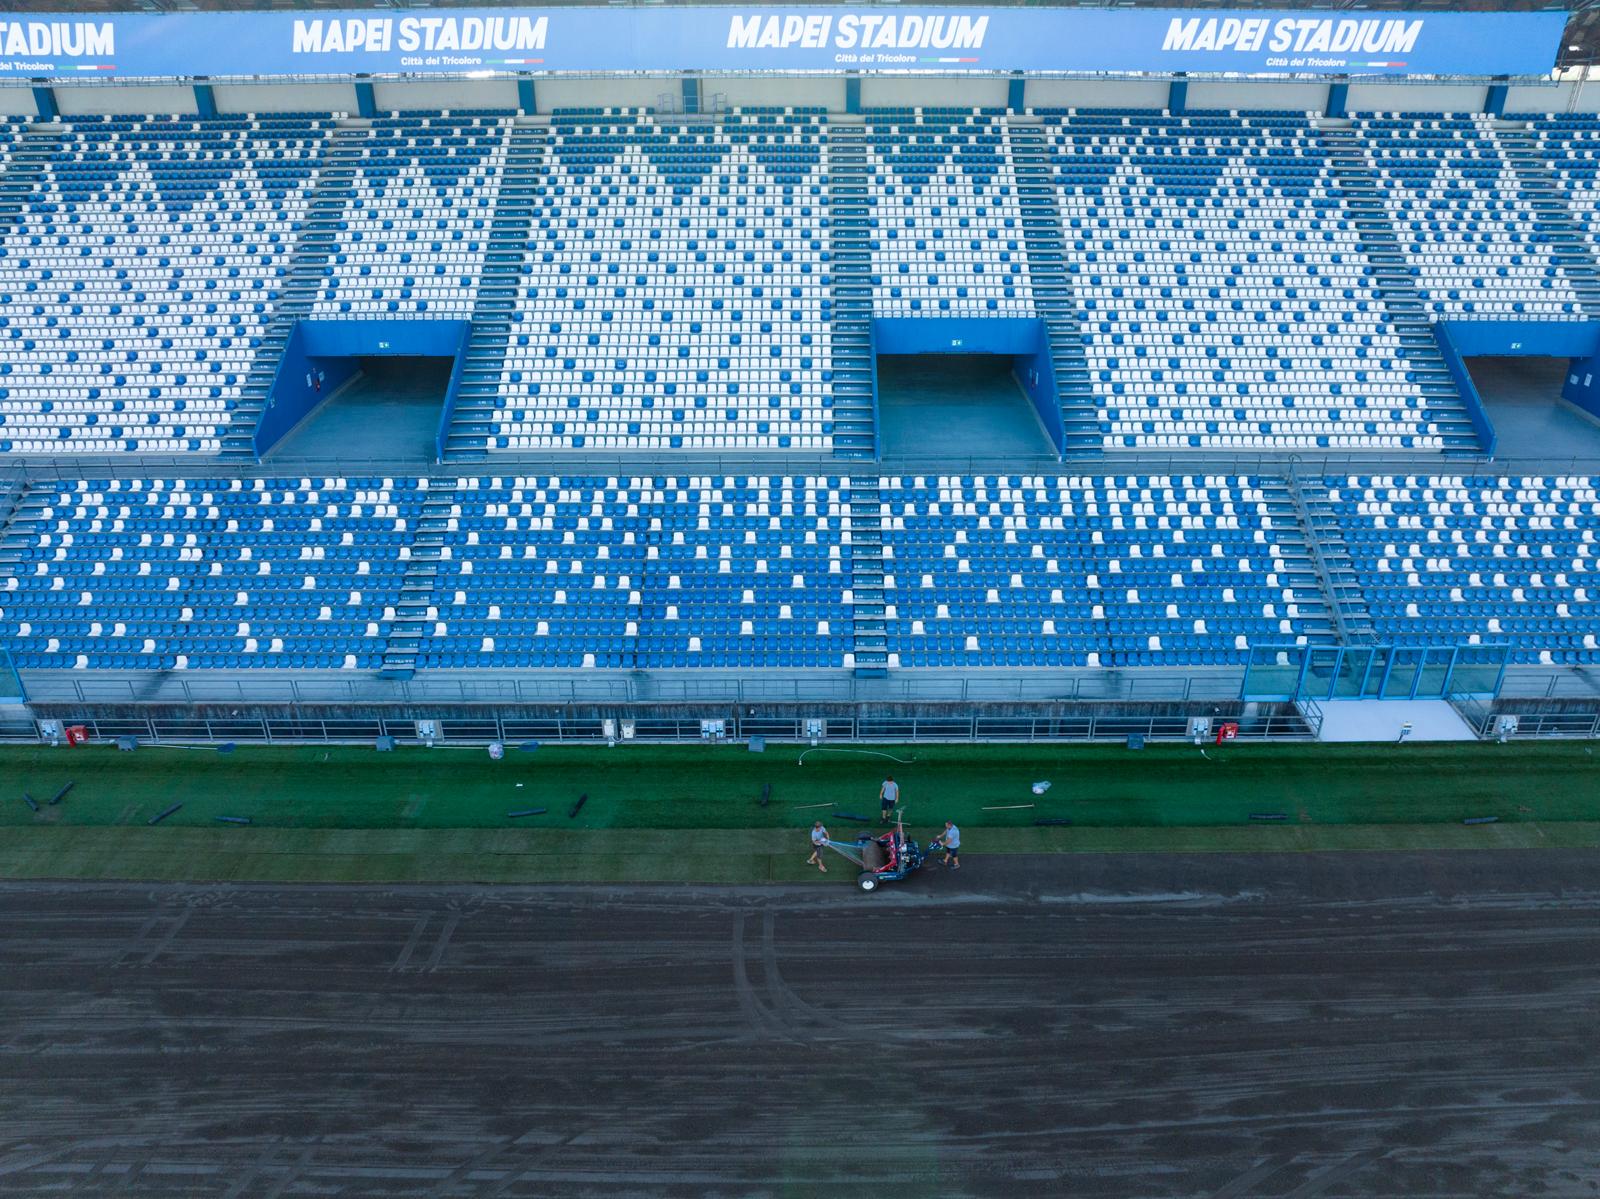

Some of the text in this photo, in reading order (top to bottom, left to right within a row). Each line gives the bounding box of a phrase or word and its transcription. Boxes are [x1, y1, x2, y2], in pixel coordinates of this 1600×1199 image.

[292, 16, 549, 53] MAPEI STADIUM
[727, 14, 990, 49] MAPEI STADIUM
[1161, 17, 1424, 53] MAPEI STADIUM
[400, 56, 482, 66] Città del Tricolore
[834, 53, 917, 64] Città del Tricolore
[1265, 57, 1347, 67] Città del Tricolore
[13, 61, 55, 71] Tricolore
